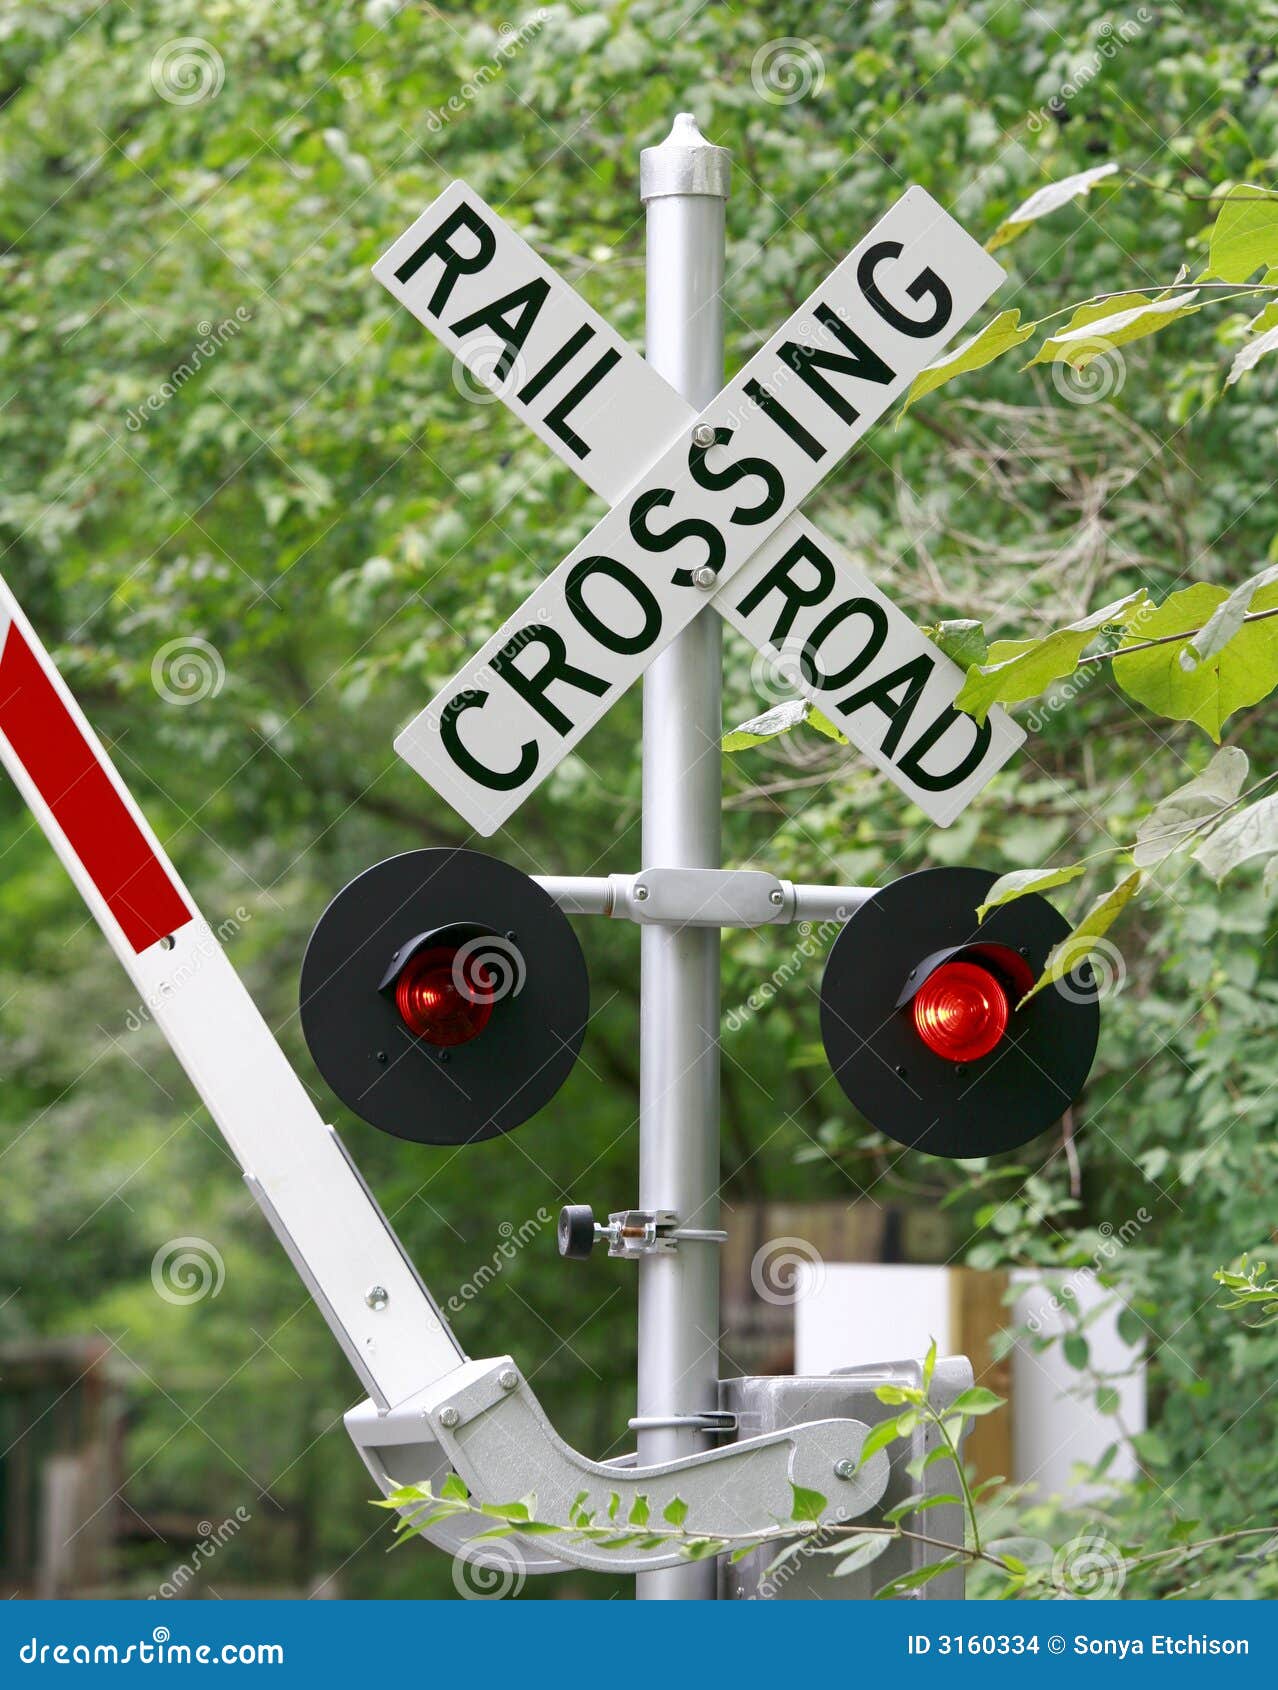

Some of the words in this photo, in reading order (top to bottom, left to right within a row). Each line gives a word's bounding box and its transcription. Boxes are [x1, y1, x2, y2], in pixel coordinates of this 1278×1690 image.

[394, 201, 623, 461] RAIL
[735, 534, 992, 792] ROAD
[439, 240, 953, 792] CROSSING
